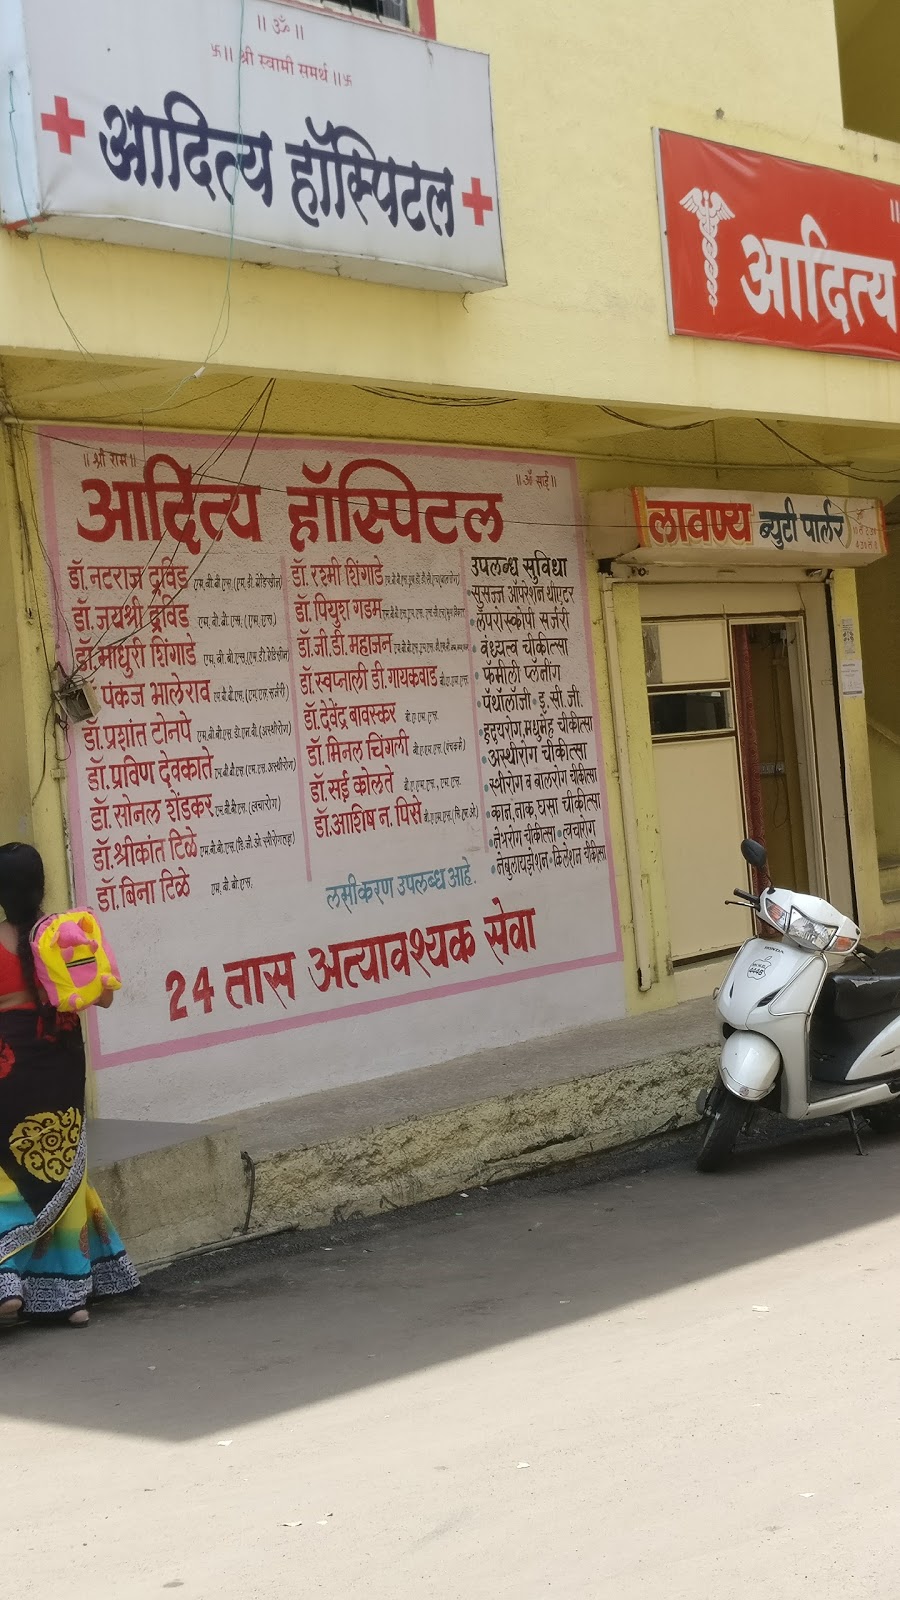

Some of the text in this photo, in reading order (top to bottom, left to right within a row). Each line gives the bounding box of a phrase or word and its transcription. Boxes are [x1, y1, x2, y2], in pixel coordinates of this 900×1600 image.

[258, 55, 294, 76] स्वामी
[298, 62, 329, 83] समर्थ
[99, 90, 454, 237] आदित्य हॉस्पिटल
[740, 213, 897, 334] आदित्य
[109, 451, 128, 468] राम
[77, 453, 503, 555] आदित्य हॉस्पिटल
[646, 496, 847, 550] लावण्य ब्युटी पार्लर
[344, 554, 384, 587] शिंगाडे
[471, 550, 568, 584] उपलब्ध सुविधा
[352, 599, 383, 619] गडम
[539, 606, 570, 632] सर्जरी
[150, 632, 196, 668] शिंगाडे
[480, 635, 519, 658] वंध्यत्व
[149, 672, 211, 707] भालेराव
[150, 711, 192, 745] टोनपे
[349, 702, 397, 727] बावस्कर
[366, 728, 410, 763] चिंगली
[488, 740, 538, 768] अस्थीरोग
[158, 746, 214, 788] देवकाते
[353, 765, 394, 796] कोलते
[524, 774, 532, 790] व
[534, 764, 568, 790] बालरोग
[165, 789, 215, 823] शेंडकर
[394, 795, 422, 827] पिसे
[168, 826, 198, 861] टिळे
[563, 814, 596, 840] त्वचारोग
[159, 866, 190, 903] टिळे
[325, 872, 394, 914] लसीकरण
[397, 868, 446, 896] उपलब्ध
[165, 897, 537, 1021] 24 तास अत्यावश्यक सेवा
[764, 945, 784, 954] HONDA
